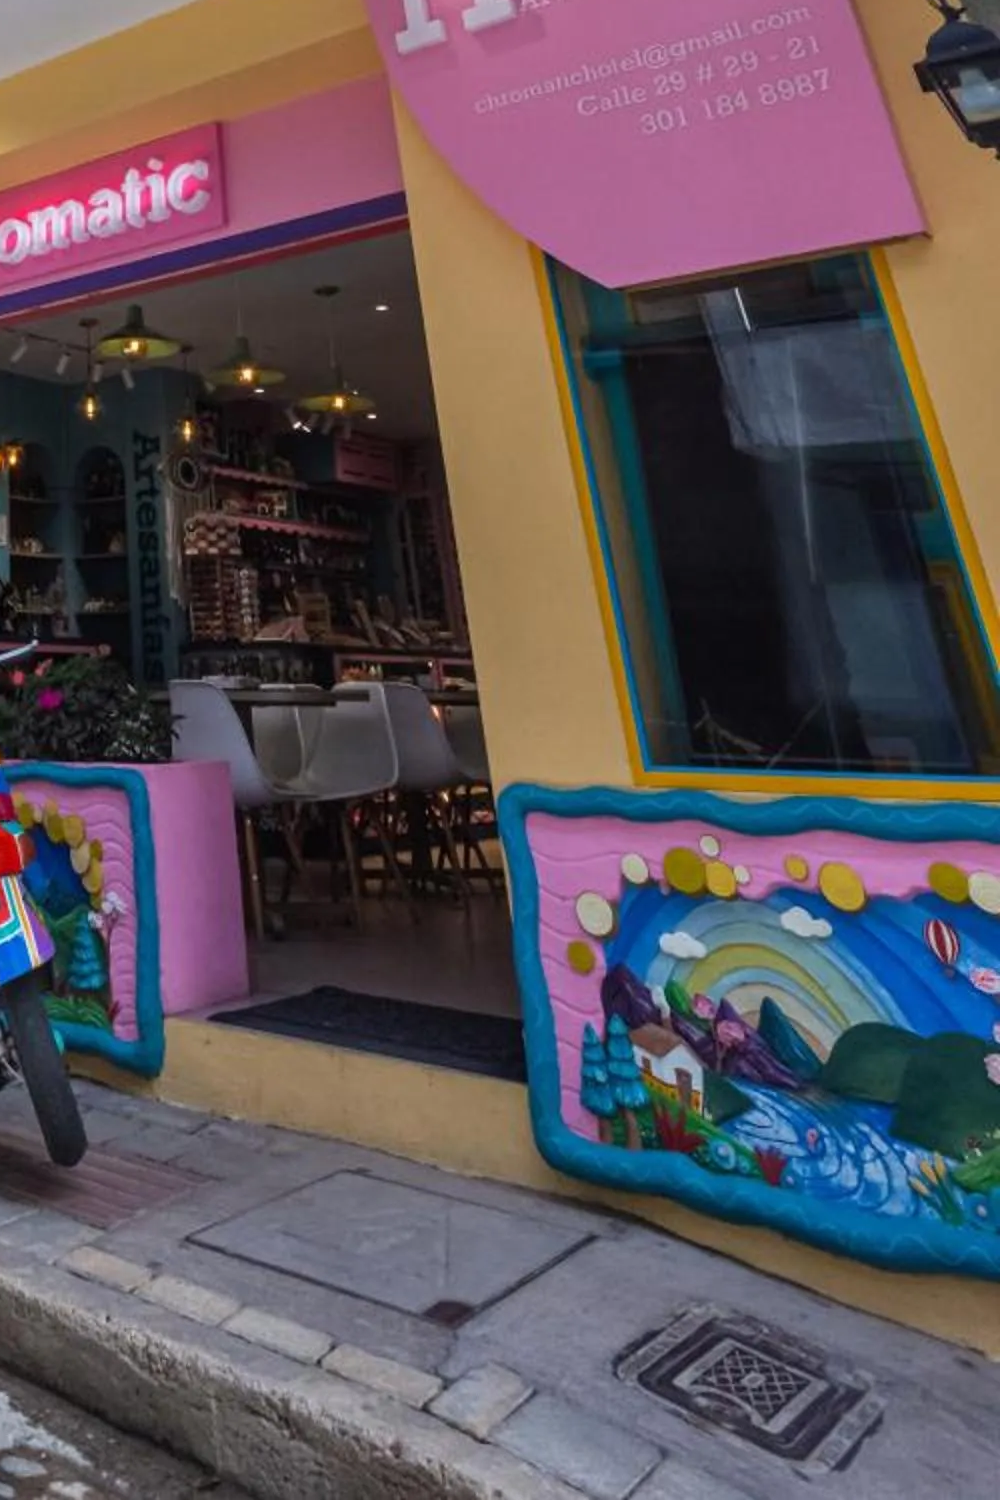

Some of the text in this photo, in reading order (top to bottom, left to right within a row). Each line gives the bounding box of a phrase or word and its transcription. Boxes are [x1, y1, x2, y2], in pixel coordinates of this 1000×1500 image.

[577, 86, 648, 116] Calle
[653, 71, 687, 97] 29
[696, 64, 714, 85] #
[723, 50, 759, 77] 29
[787, 36, 821, 61] 21
[640, 68, 832, 135] 301 184 8987
